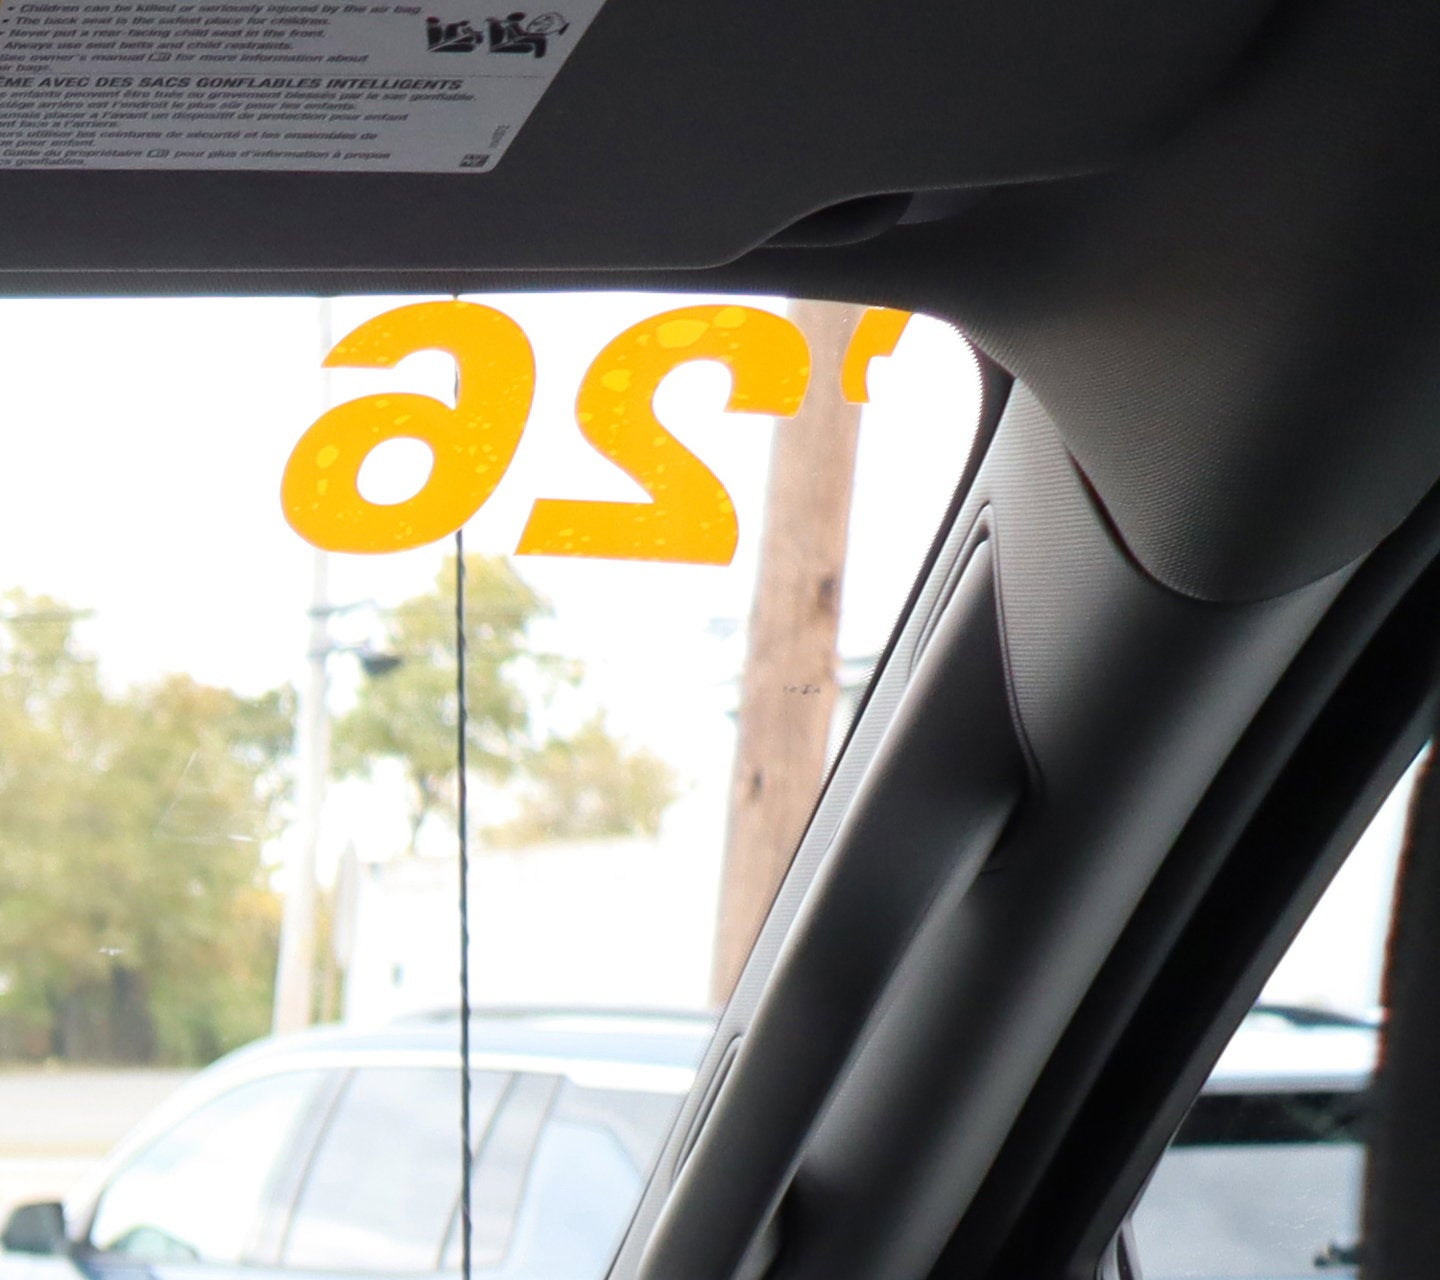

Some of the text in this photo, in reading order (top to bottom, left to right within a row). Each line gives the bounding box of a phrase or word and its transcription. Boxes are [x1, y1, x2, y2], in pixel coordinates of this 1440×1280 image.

[37, 77, 90, 87] AVEC
[94, 76, 133, 87] DES
[137, 76, 191, 87] SACS
[195, 77, 322, 88] GONFLABLES
[325, 78, 463, 90] INTELLIGENTS
